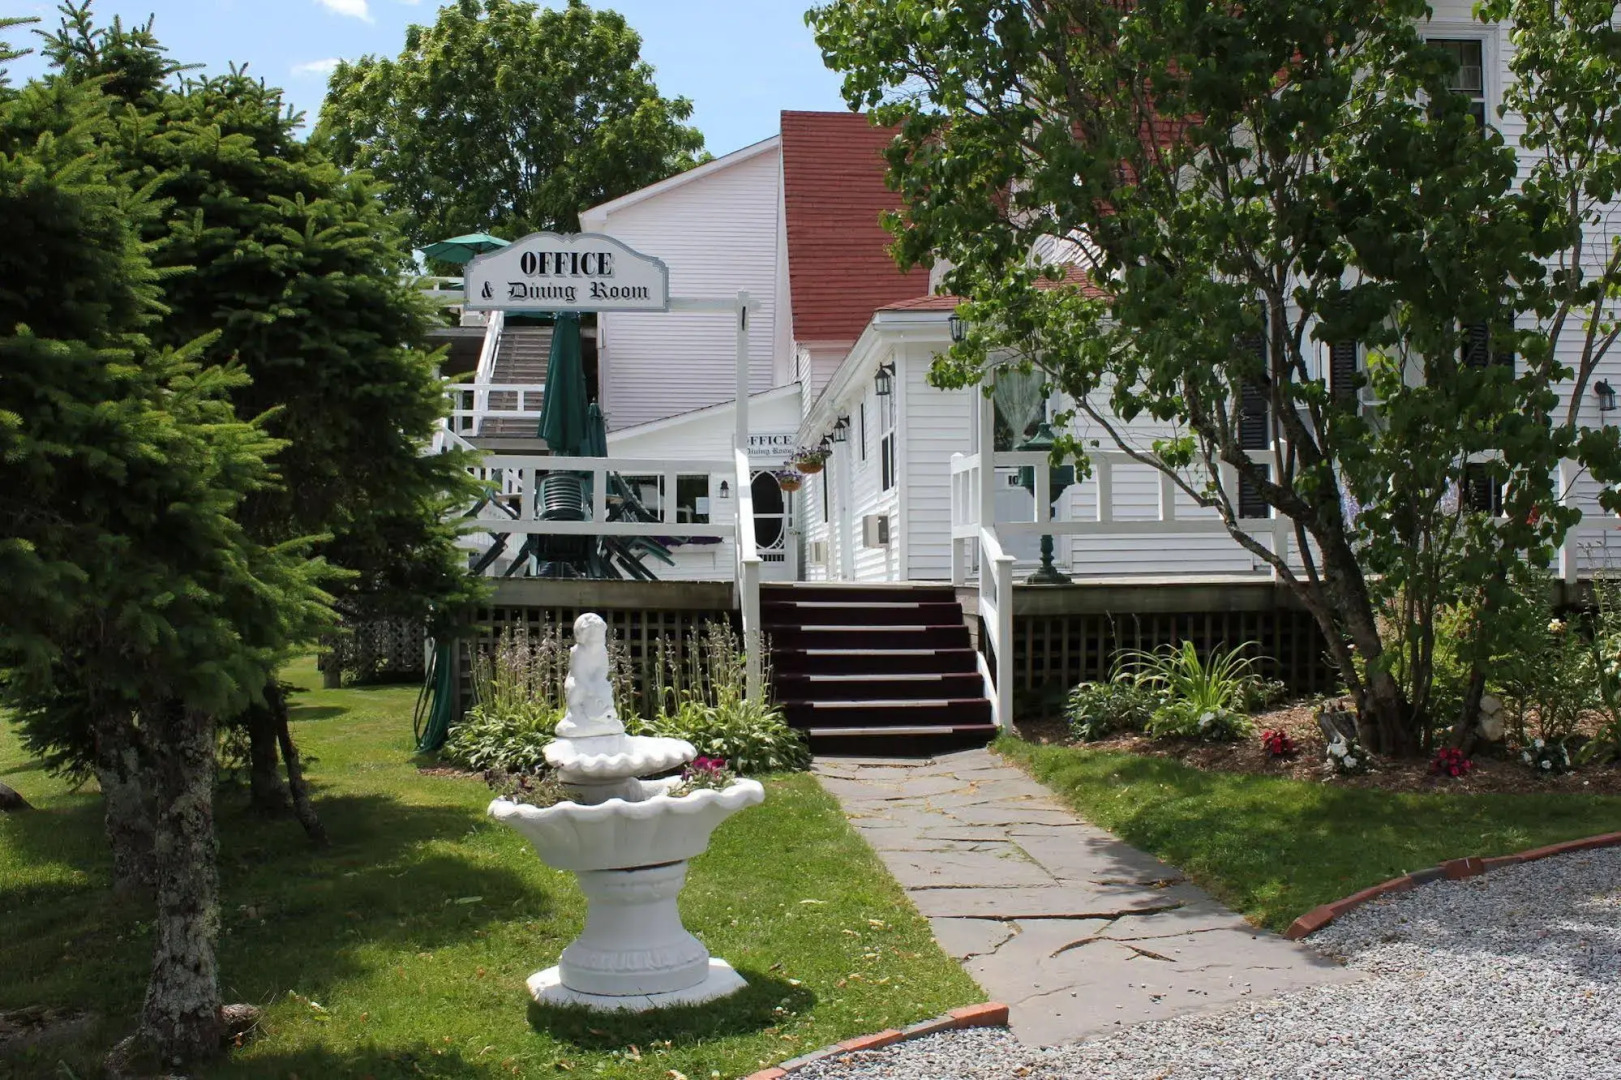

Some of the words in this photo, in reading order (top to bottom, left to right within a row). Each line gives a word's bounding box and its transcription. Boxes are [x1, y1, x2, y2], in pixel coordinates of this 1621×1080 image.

[520, 251, 613, 276] OFFICE
[481, 281, 493, 299] &
[507, 281, 577, 301] Dining
[590, 281, 649, 299] Room
[747, 435, 792, 446] FFICE
